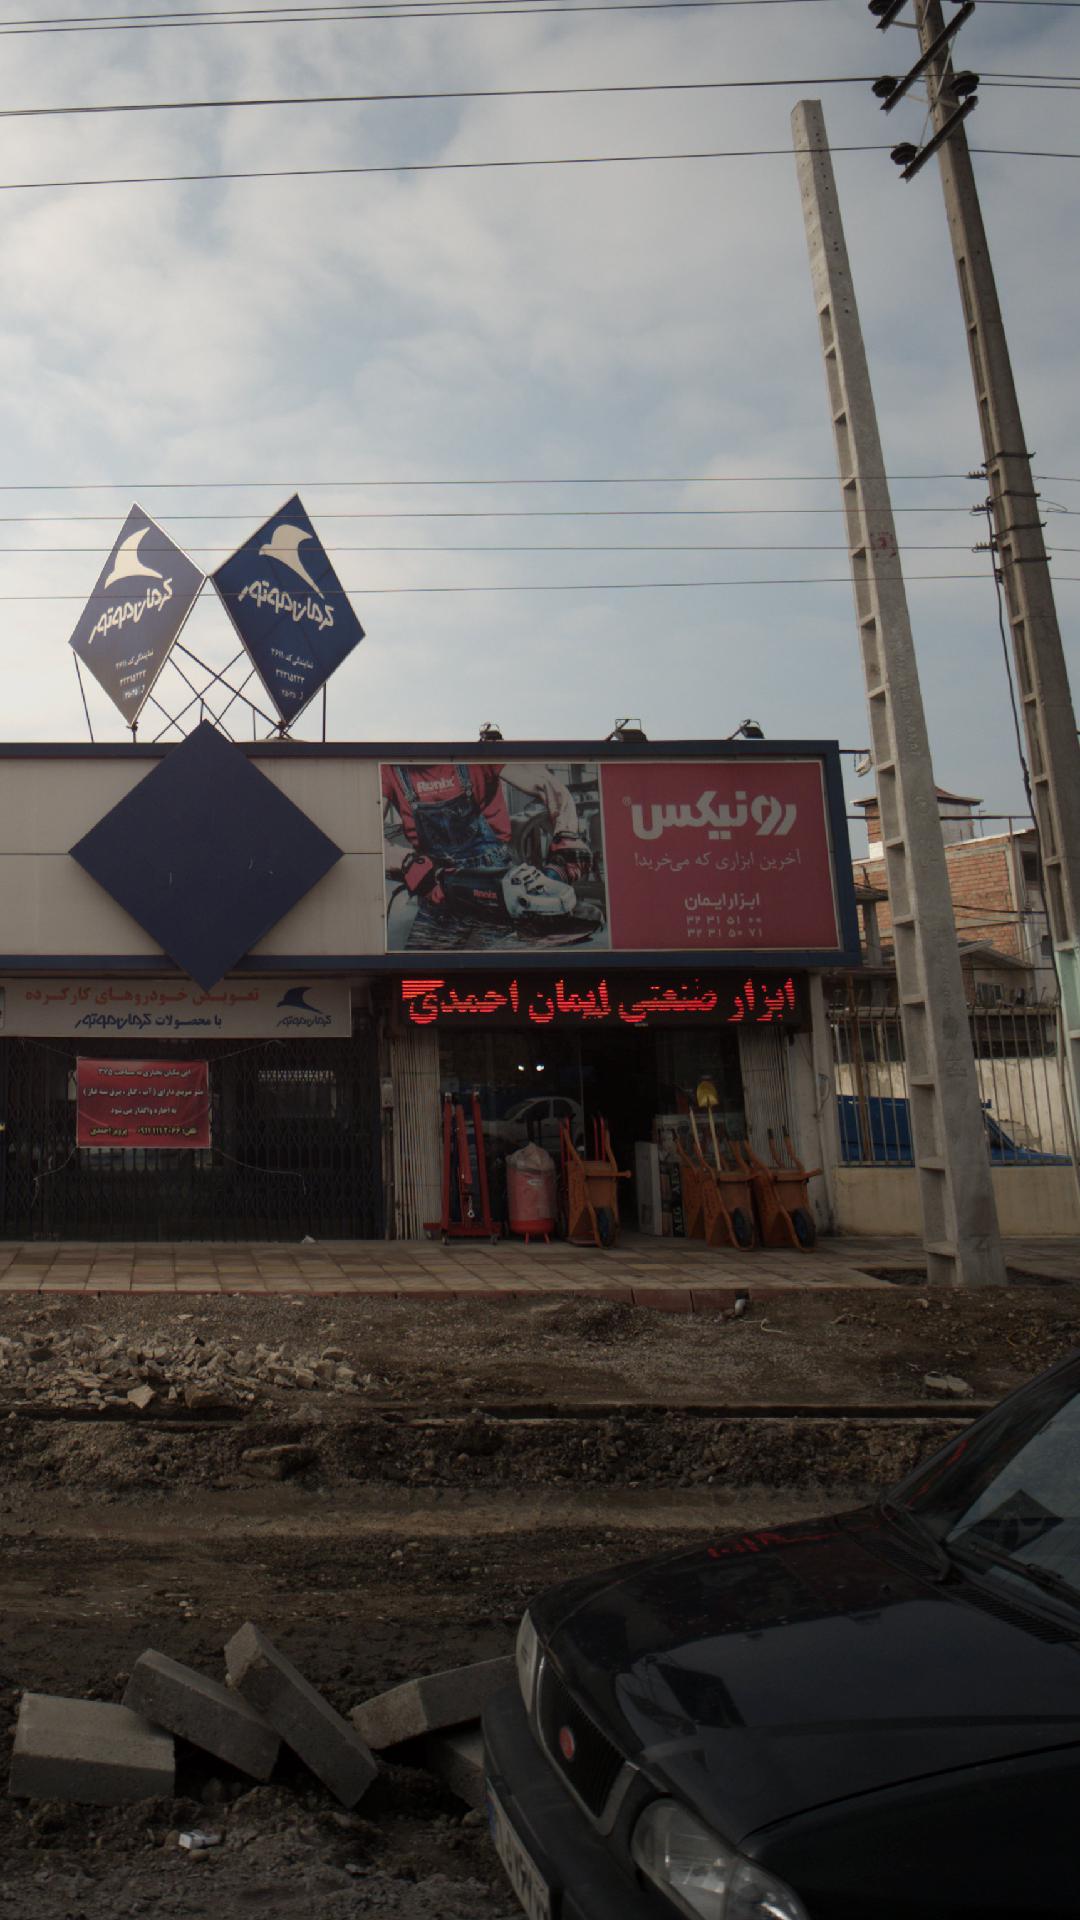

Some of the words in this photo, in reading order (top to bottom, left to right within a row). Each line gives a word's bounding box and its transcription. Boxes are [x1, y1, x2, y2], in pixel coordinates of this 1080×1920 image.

[631, 790, 798, 840] رونیکس
[695, 851, 712, 866] که
[715, 851, 754, 871] ابزاری
[760, 848, 801, 871] آخرین
[528, 978, 612, 1023] ایمان
[727, 977, 796, 1021] ابزار
[154, 1014, 212, 1029] محصولات
[213, 1014, 223, 1029] با
